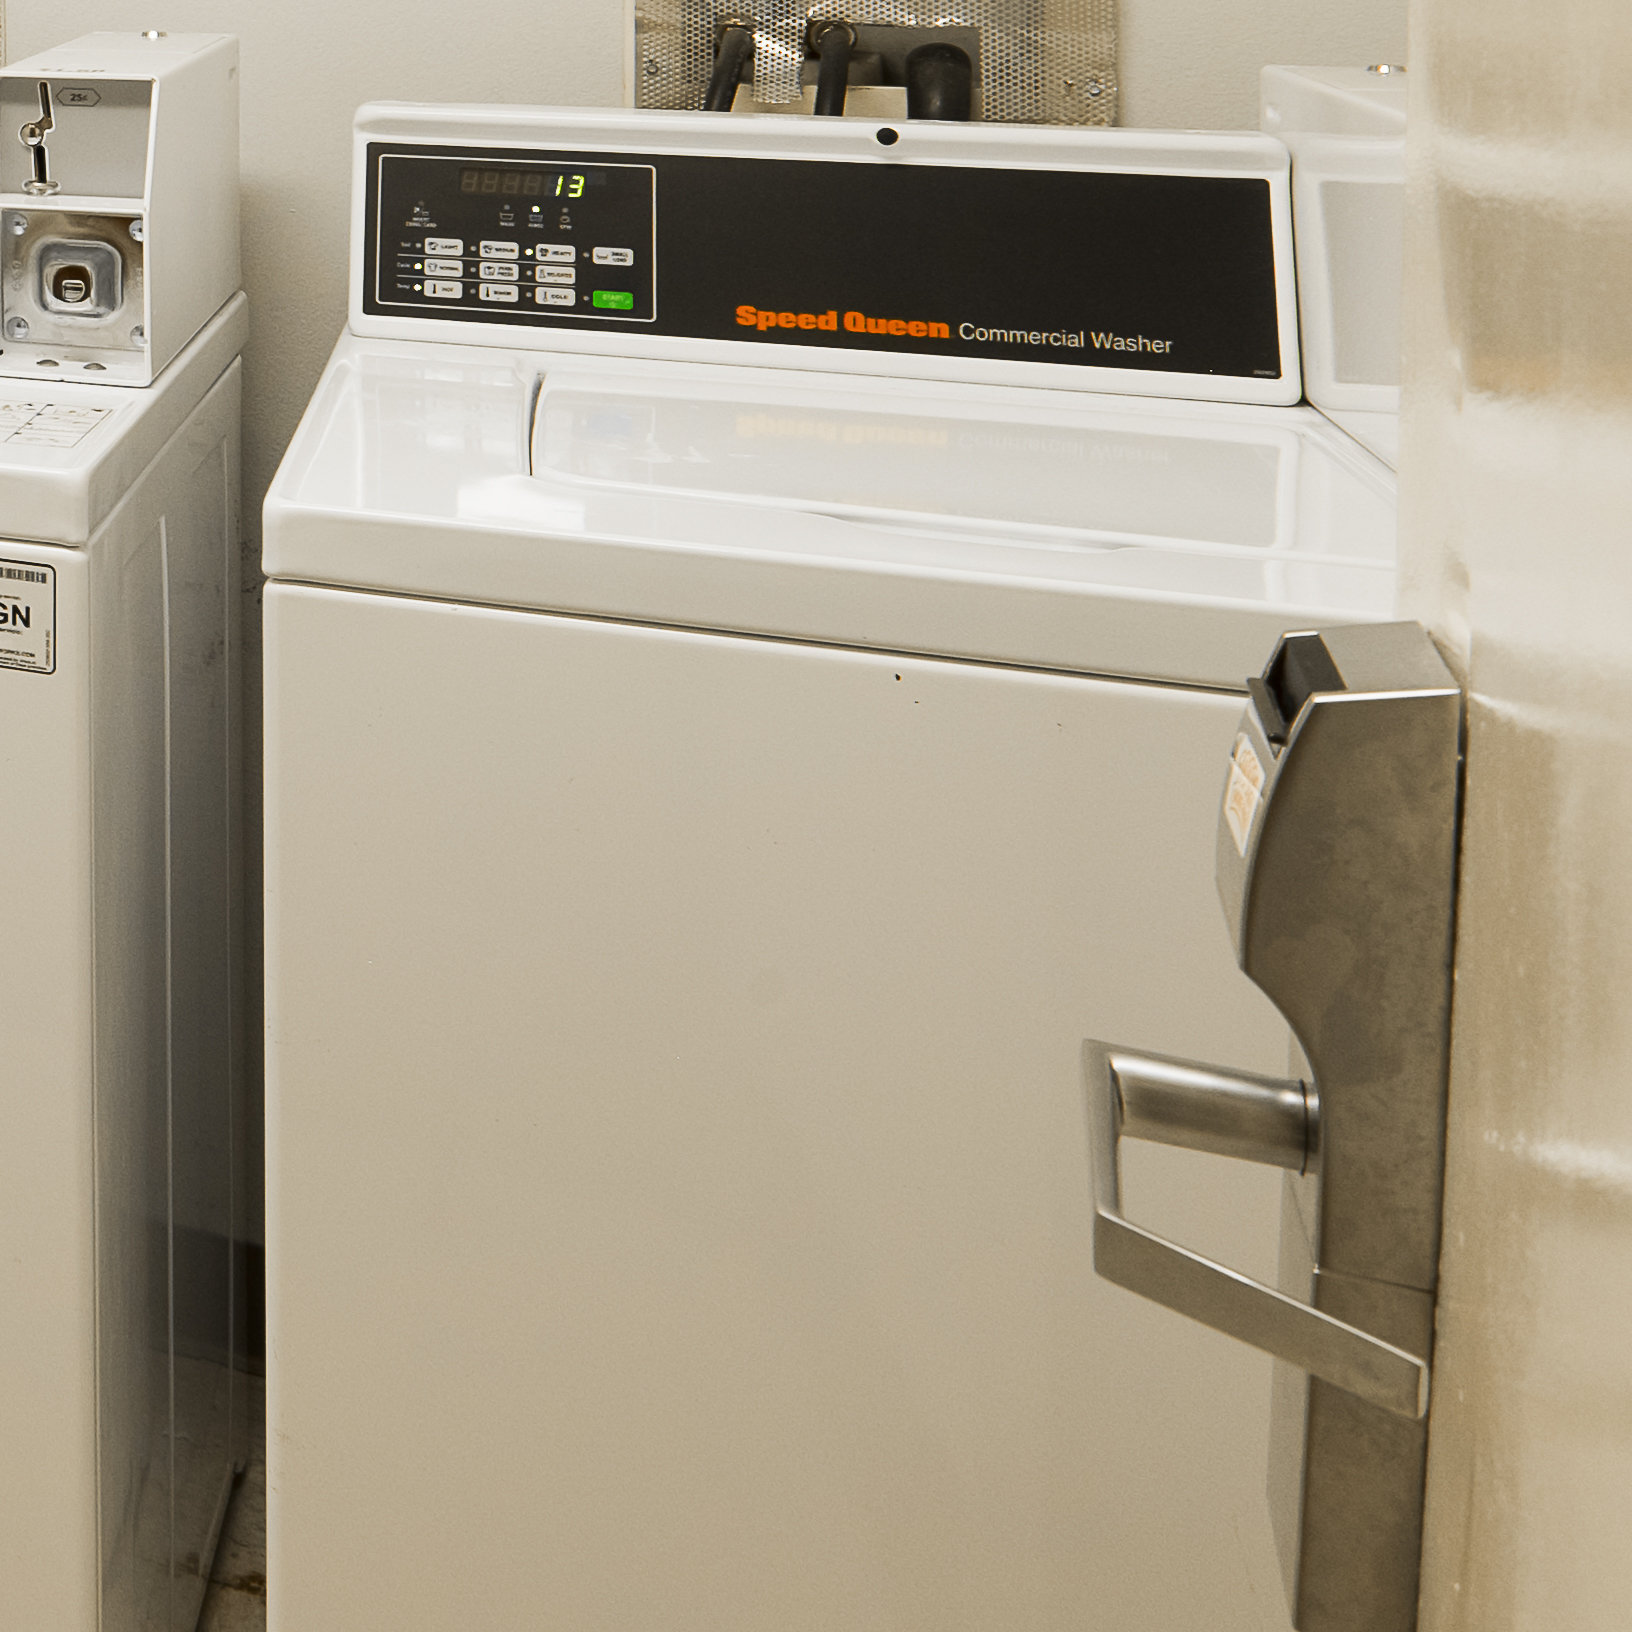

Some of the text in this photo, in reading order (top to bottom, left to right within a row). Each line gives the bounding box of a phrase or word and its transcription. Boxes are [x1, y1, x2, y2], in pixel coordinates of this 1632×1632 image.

[555, 175, 585, 198] 13
[736, 305, 1173, 355] Speed Queen Commercial Washer
